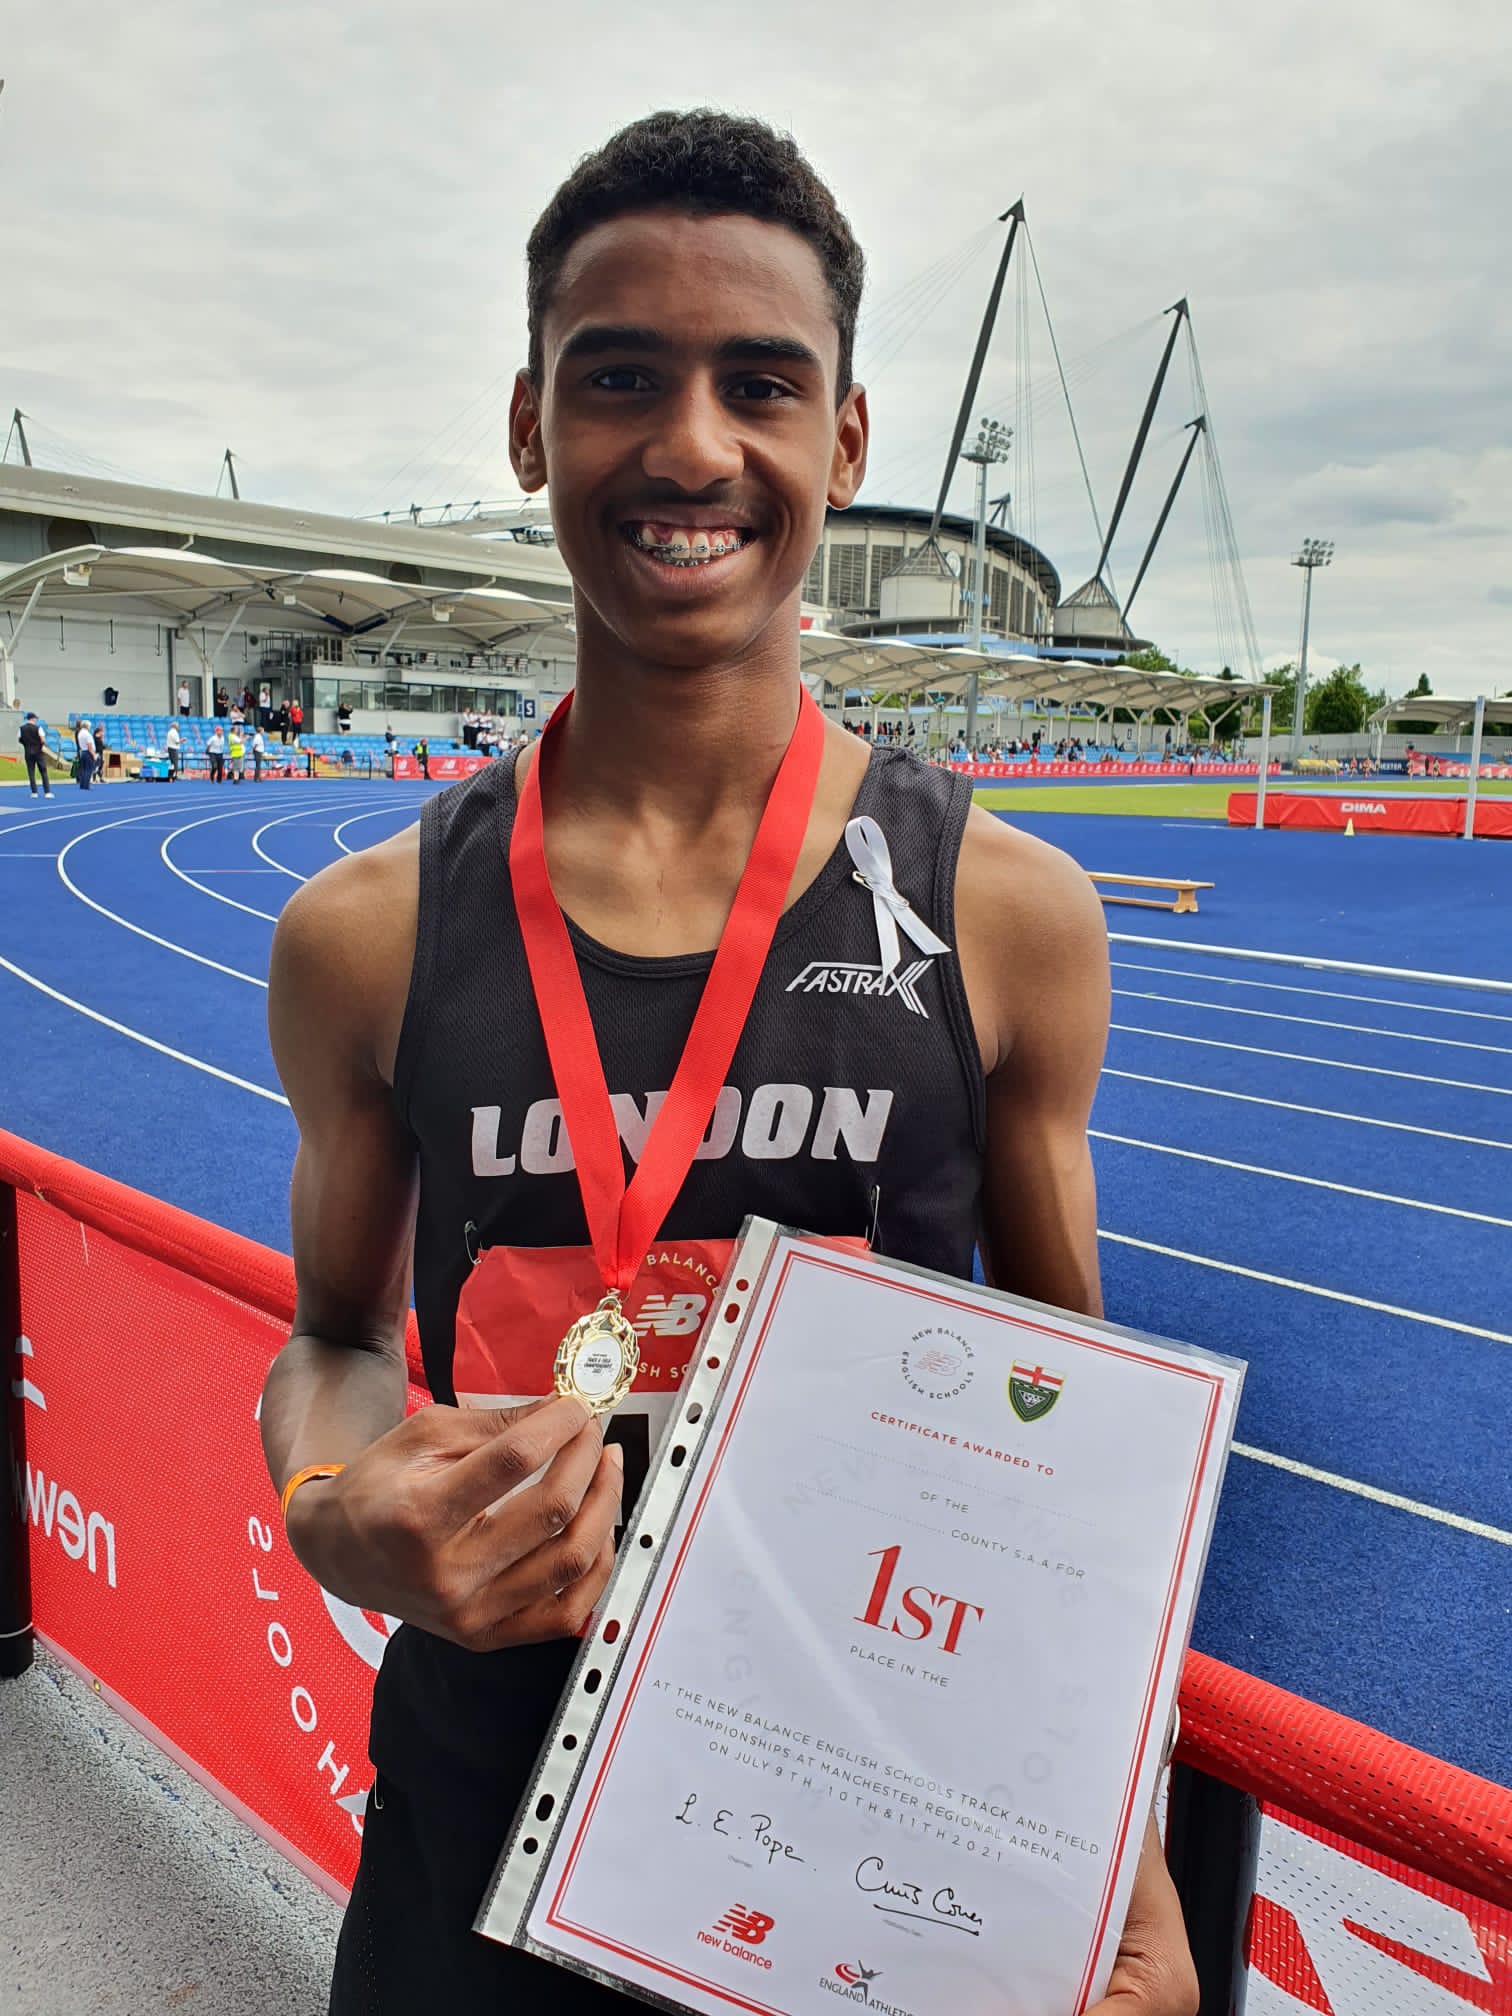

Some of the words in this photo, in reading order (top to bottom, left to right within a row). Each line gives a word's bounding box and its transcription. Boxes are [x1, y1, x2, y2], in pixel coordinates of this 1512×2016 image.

[1340, 802, 1386, 814] DIMA
[646, 1252, 721, 1297] BALANCE
[912, 1328, 933, 1342] NEW
[937, 1328, 975, 1359] BALANCE
[902, 1351, 925, 1395] ENGLISH
[929, 1371, 974, 1399] SCHOOLS
[871, 1411, 958, 1445] CERTIFICATE
[963, 1441, 1031, 1468] AWARDED
[1037, 1464, 1054, 1476] TO
[920, 1490, 938, 1502] OF
[945, 1498, 969, 1513] THE
[951, 1529, 1009, 1553] COUNTY
[1056, 1563, 1086, 1579] FOR
[853, 1544, 985, 1656] 1ST
[850, 1645, 897, 1669] PLACE
[900, 1663, 915, 1676] IN
[921, 1670, 950, 1687] THE
[653, 1679, 671, 1691] AT
[677, 1687, 702, 1704] THE
[707, 1699, 739, 1717] NEW
[744, 1713, 811, 1745] BALANCE
[816, 1740, 878, 1770] ENGLISH
[884, 1766, 955, 1799] SCHOOLS
[960, 1793, 1010, 1820] TRACK
[1016, 1816, 1048, 1835] AND
[1055, 1830, 1100, 1855] FIELD
[675, 1708, 791, 1758] CHAMPIONSHIPS
[796, 1753, 816, 1766] AT
[820, 1762, 919, 1807] MANCHESTER
[925, 1802, 1003, 1840] REGIONAL
[709, 1741, 729, 1755] ON
[734, 1752, 769, 1771] JULY
[696, 1929, 722, 1949] new
[723, 1938, 774, 1970] balance
[819, 1977, 864, 2003] ENGLAND
